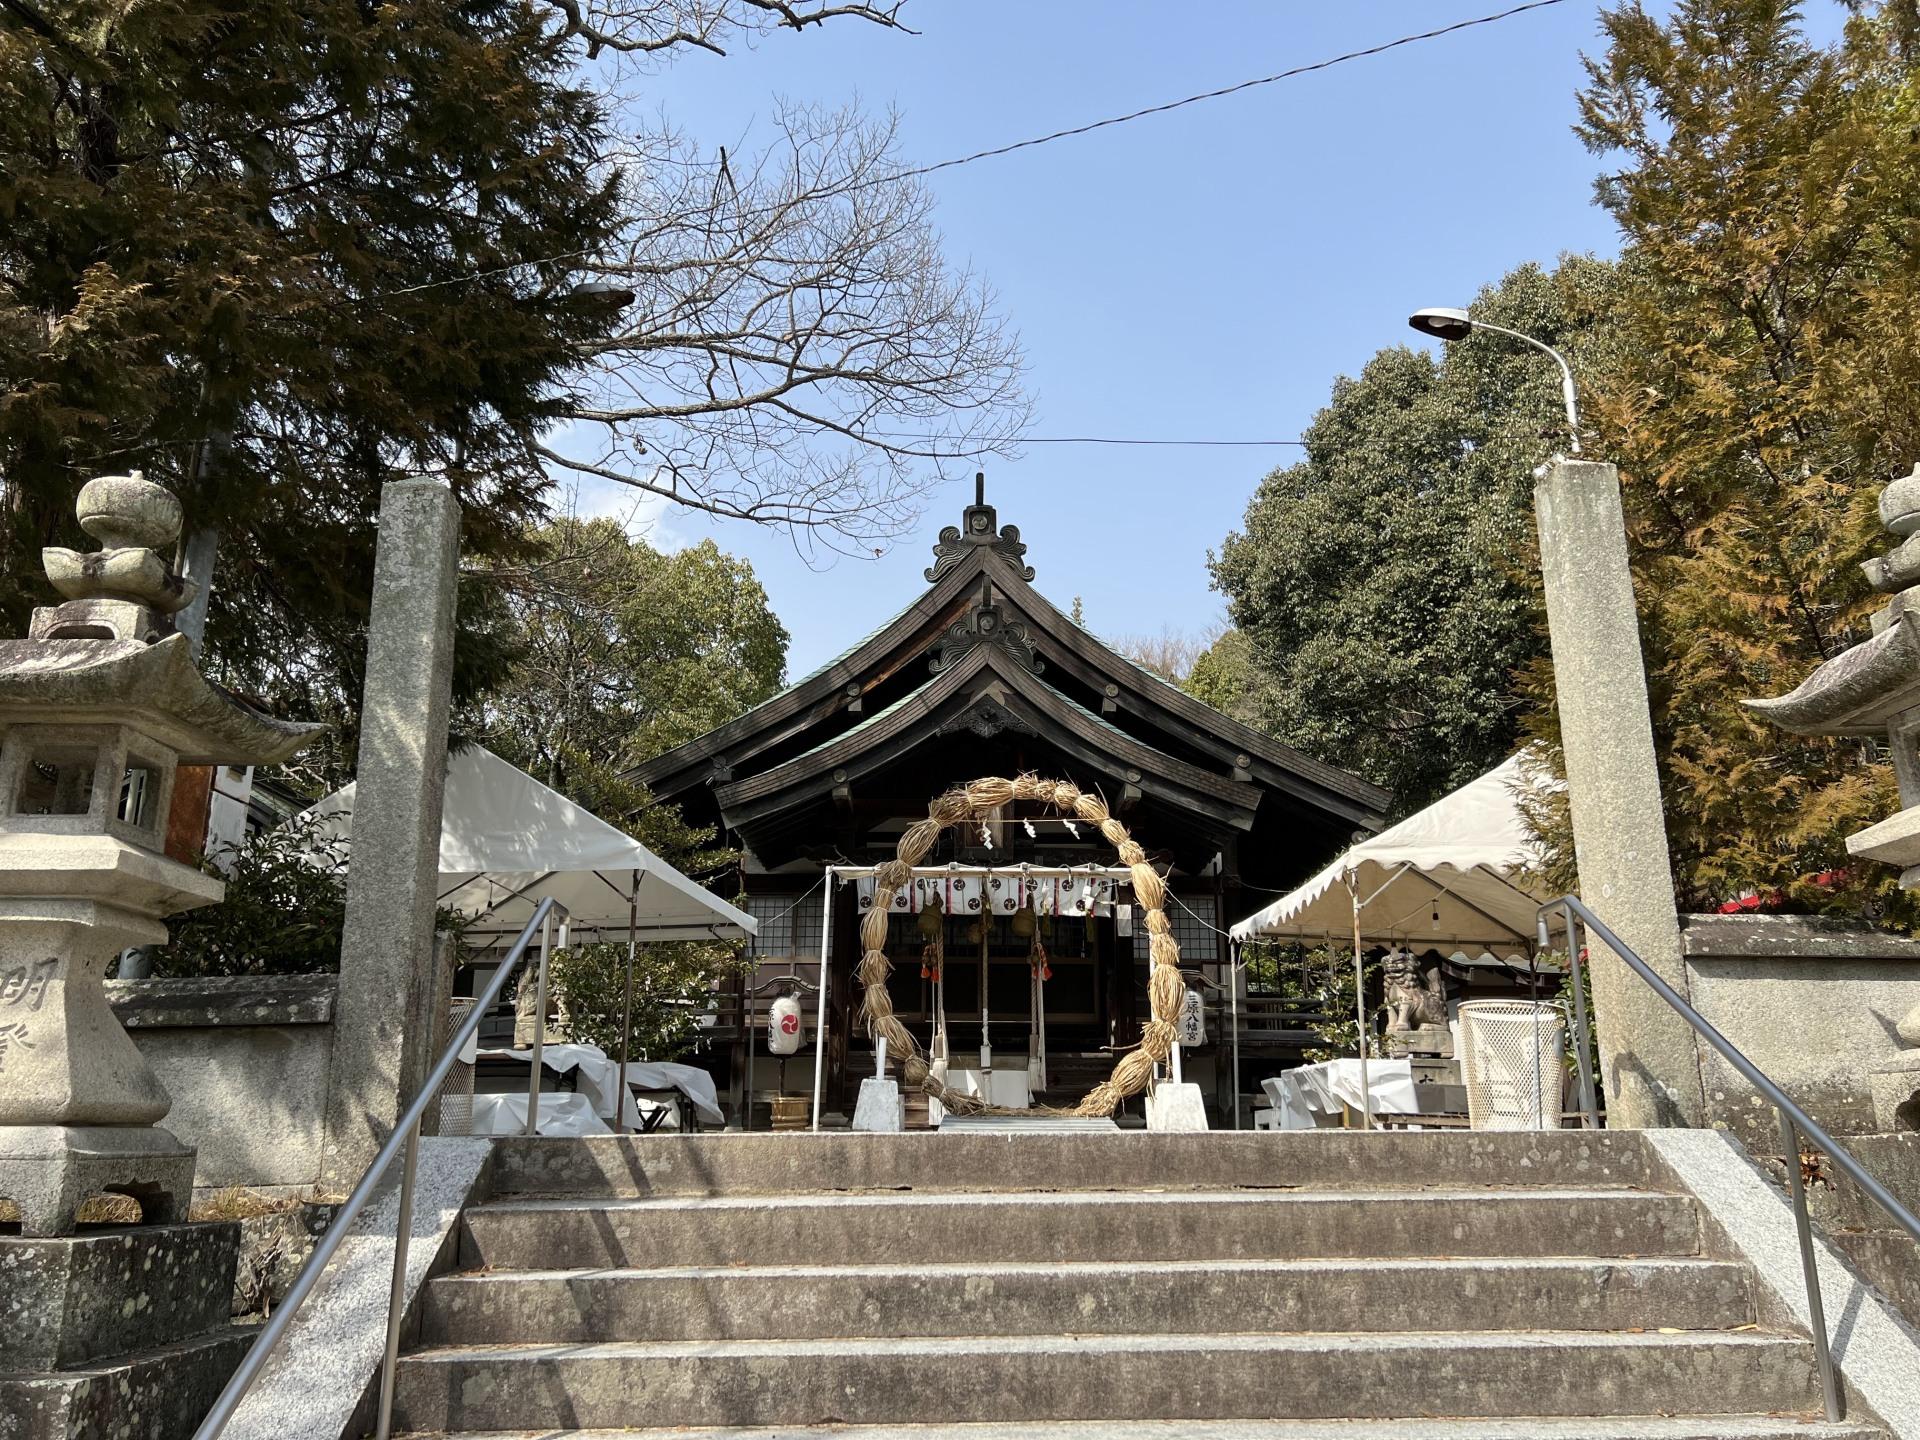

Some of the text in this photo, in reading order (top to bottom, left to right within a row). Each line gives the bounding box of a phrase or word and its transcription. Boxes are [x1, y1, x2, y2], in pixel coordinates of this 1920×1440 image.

[1185, 994, 1199, 1041] 三原八幡宮
